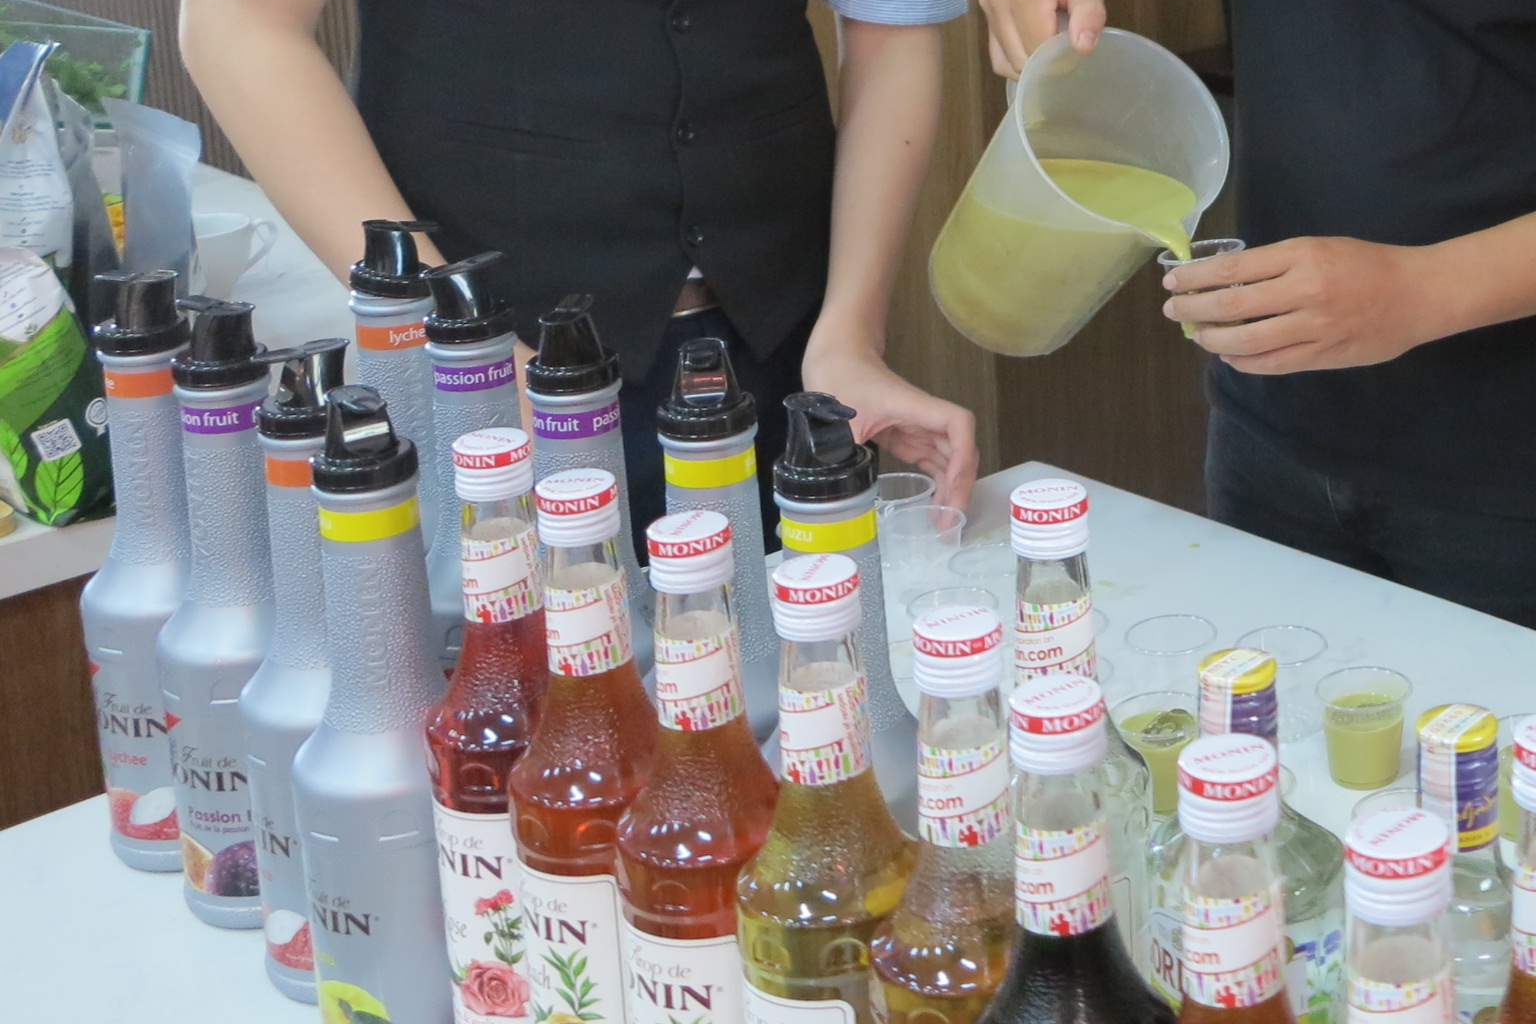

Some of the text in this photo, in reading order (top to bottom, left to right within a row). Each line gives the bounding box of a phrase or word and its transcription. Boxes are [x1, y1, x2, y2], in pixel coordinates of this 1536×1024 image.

[389, 327, 427, 346] lyche
[434, 362, 514, 386] passion fruit
[203, 411, 240, 427] fruit
[546, 416, 580, 433] fruit
[455, 453, 496, 469] ONIN
[539, 495, 600, 515] MONIN
[1019, 503, 1081, 523] MONIN
[658, 533, 724, 558] MONIN
[789, 578, 855, 604] MONIN
[133, 702, 152, 715] de
[100, 712, 168, 738] NIN
[217, 755, 237, 768] de
[173, 762, 248, 792] ONIN
[463, 836, 484, 850] de
[441, 844, 504, 881] NIN
[547, 898, 568, 914] de
[312, 902, 372, 937] NIN
[523, 905, 589, 946] NIN
[667, 960, 692, 978] de
[628, 963, 714, 1011] NIN
